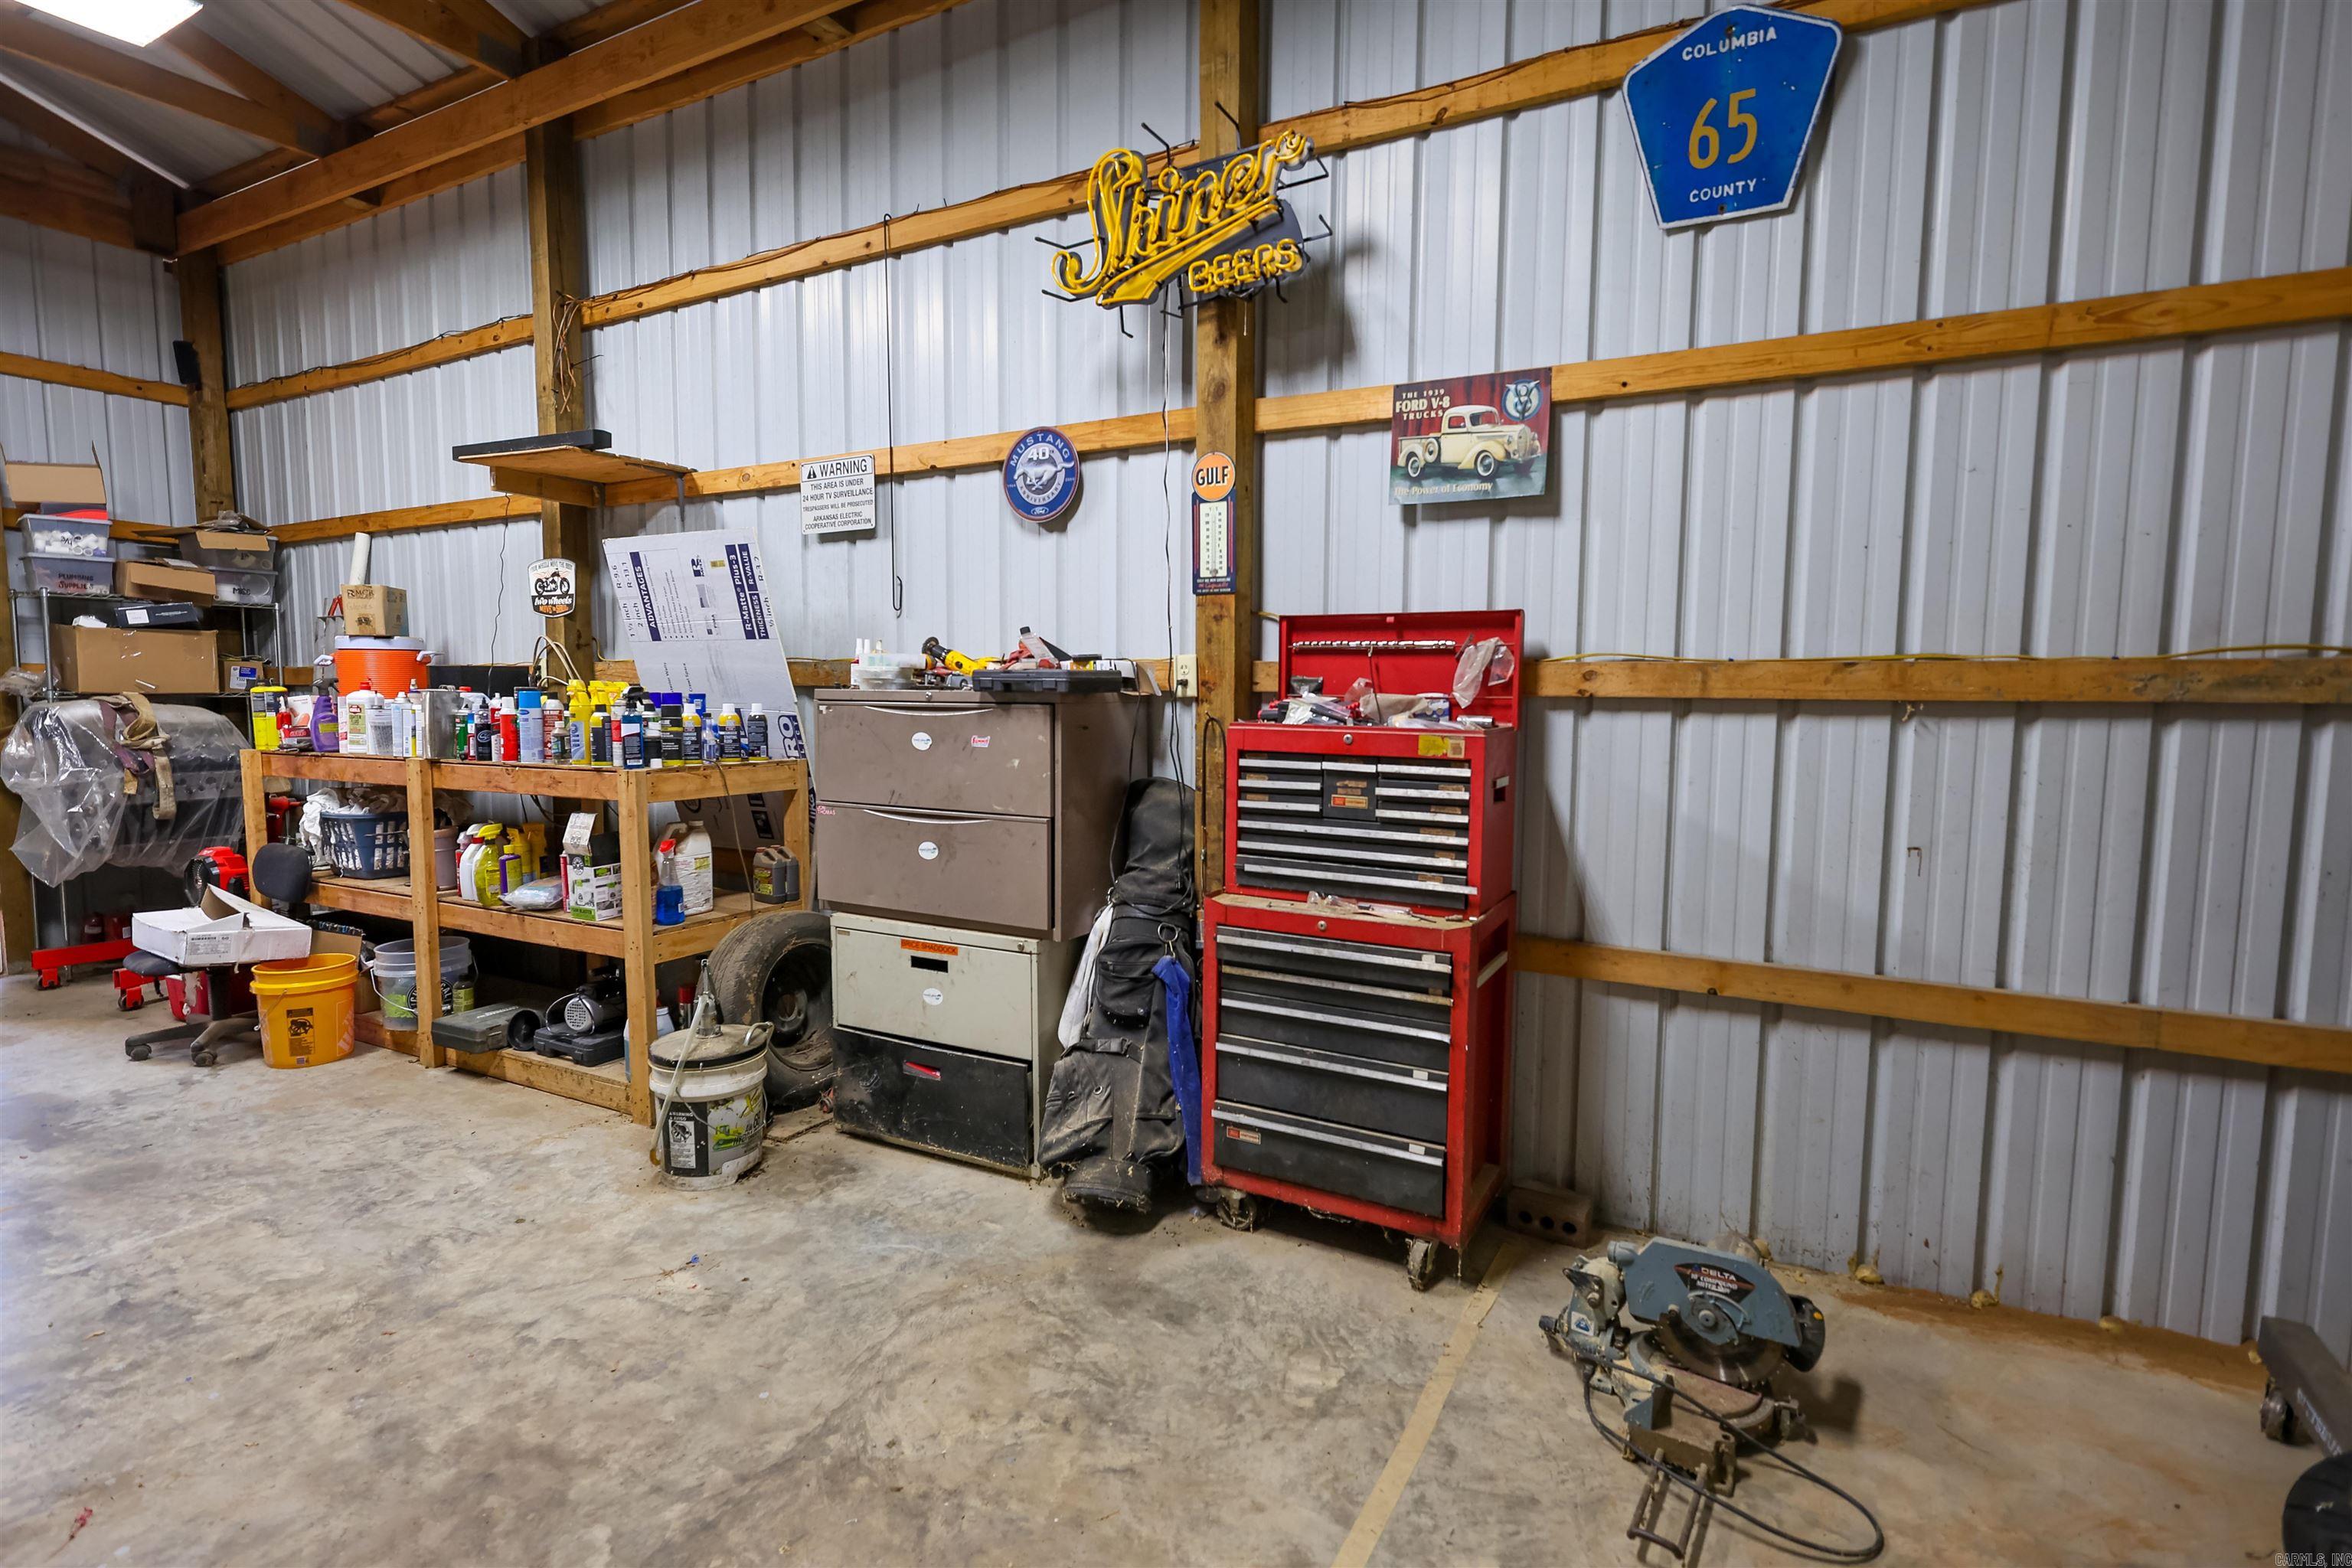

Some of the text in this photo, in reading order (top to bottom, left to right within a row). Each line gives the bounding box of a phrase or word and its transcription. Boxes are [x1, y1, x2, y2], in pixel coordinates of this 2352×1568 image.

[1682, 26, 1777, 61] COLUMBIA
[1688, 87, 1758, 169] 65
[1689, 178, 1757, 203] COUNTY
[1052, 129, 1308, 295] Shiner
[1188, 238, 1305, 293] BEERS
[1402, 388, 1445, 399] THE 1939
[1395, 395, 1450, 413] FORD V-8
[1403, 410, 1443, 420] TRUCKS
[1010, 433, 1070, 466] MUSTANG
[819, 459, 867, 477] WARNING
[1196, 466, 1230, 487] GULF
[810, 482, 822, 491] THIS
[823, 481, 838, 489] AREA
[845, 478, 864, 487] UNDER
[1412, 485, 1438, 495] Power
[1441, 484, 1450, 493] of
[1453, 482, 1493, 495] Economy
[810, 493, 825, 501] HOUR
[833, 487, 873, 499] SURVEILLANCE
[802, 504, 830, 512] TRESPASSERS
[847, 499, 874, 508] PROSECUTED
[805, 518, 872, 531] COOPERATIVE CORPORATION
[813, 511, 863, 521] ARKANSAS ELECTRIC
[729, 554, 742, 585] Plus-3
[634, 565, 657, 629] ADVANTAGES
[742, 550, 766, 638] THICKNESS R-VALUE
[1700, 1266, 1736, 1282] DELTA
